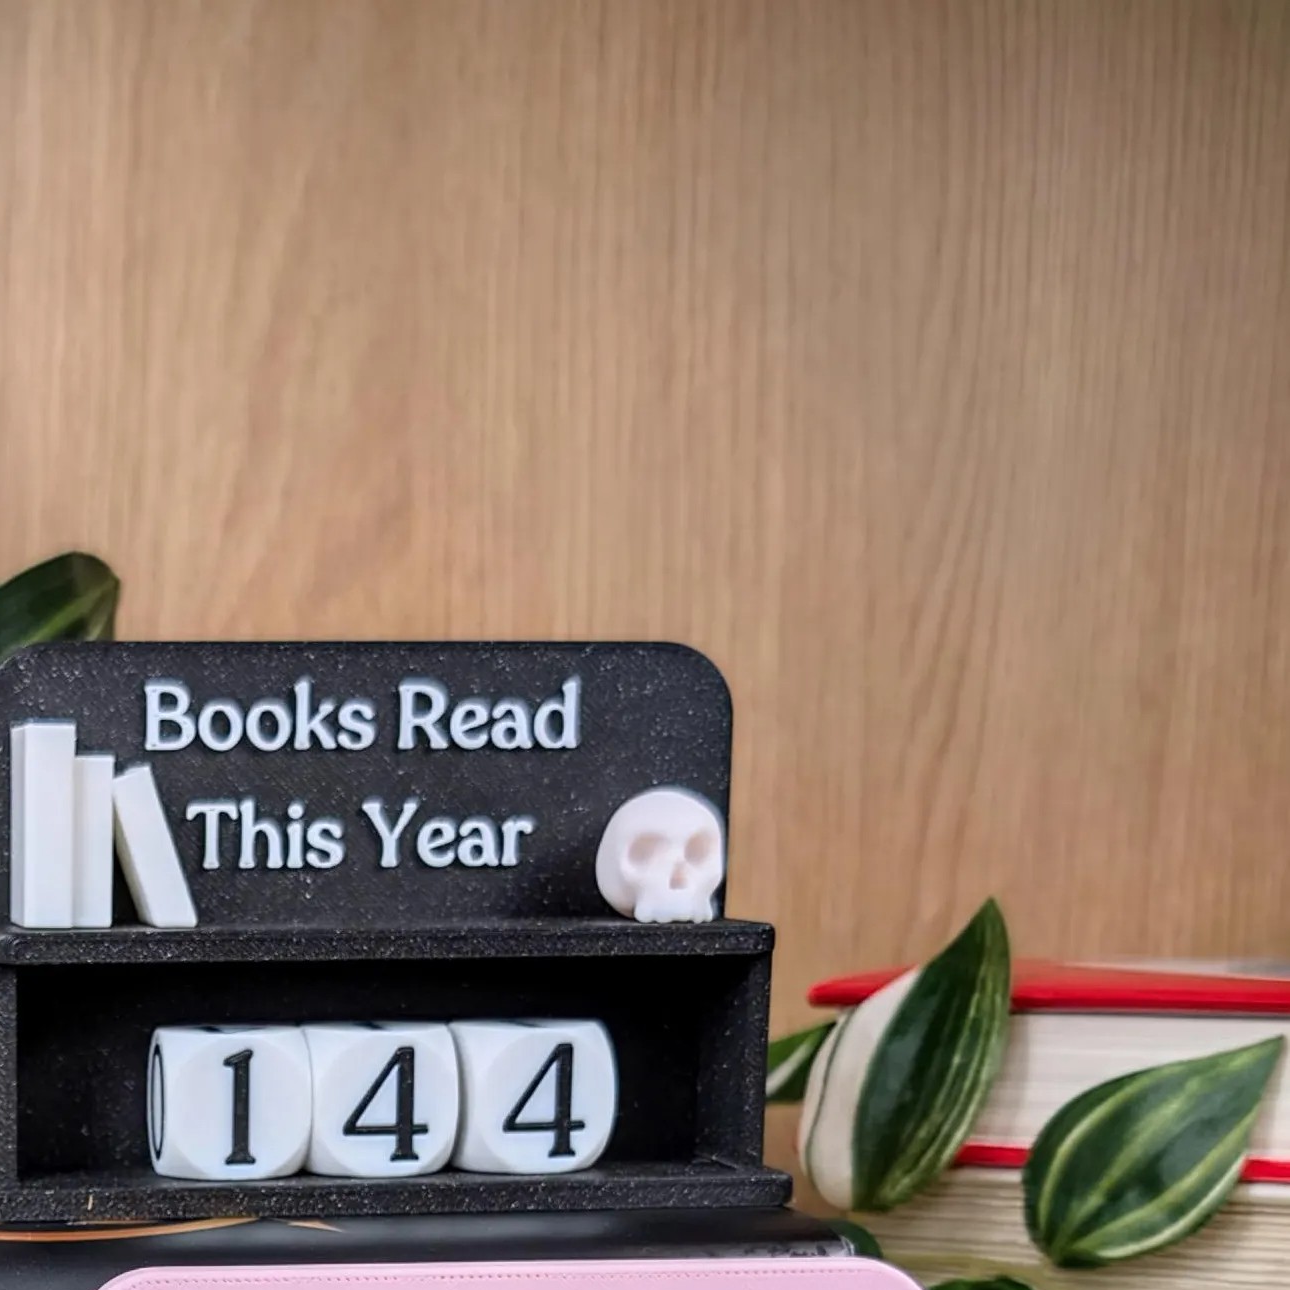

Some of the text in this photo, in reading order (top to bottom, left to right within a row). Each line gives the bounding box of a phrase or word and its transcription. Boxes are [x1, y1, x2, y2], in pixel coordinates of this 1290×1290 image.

[144, 676, 581, 752] Books Read
[185, 798, 534, 870] This Year
